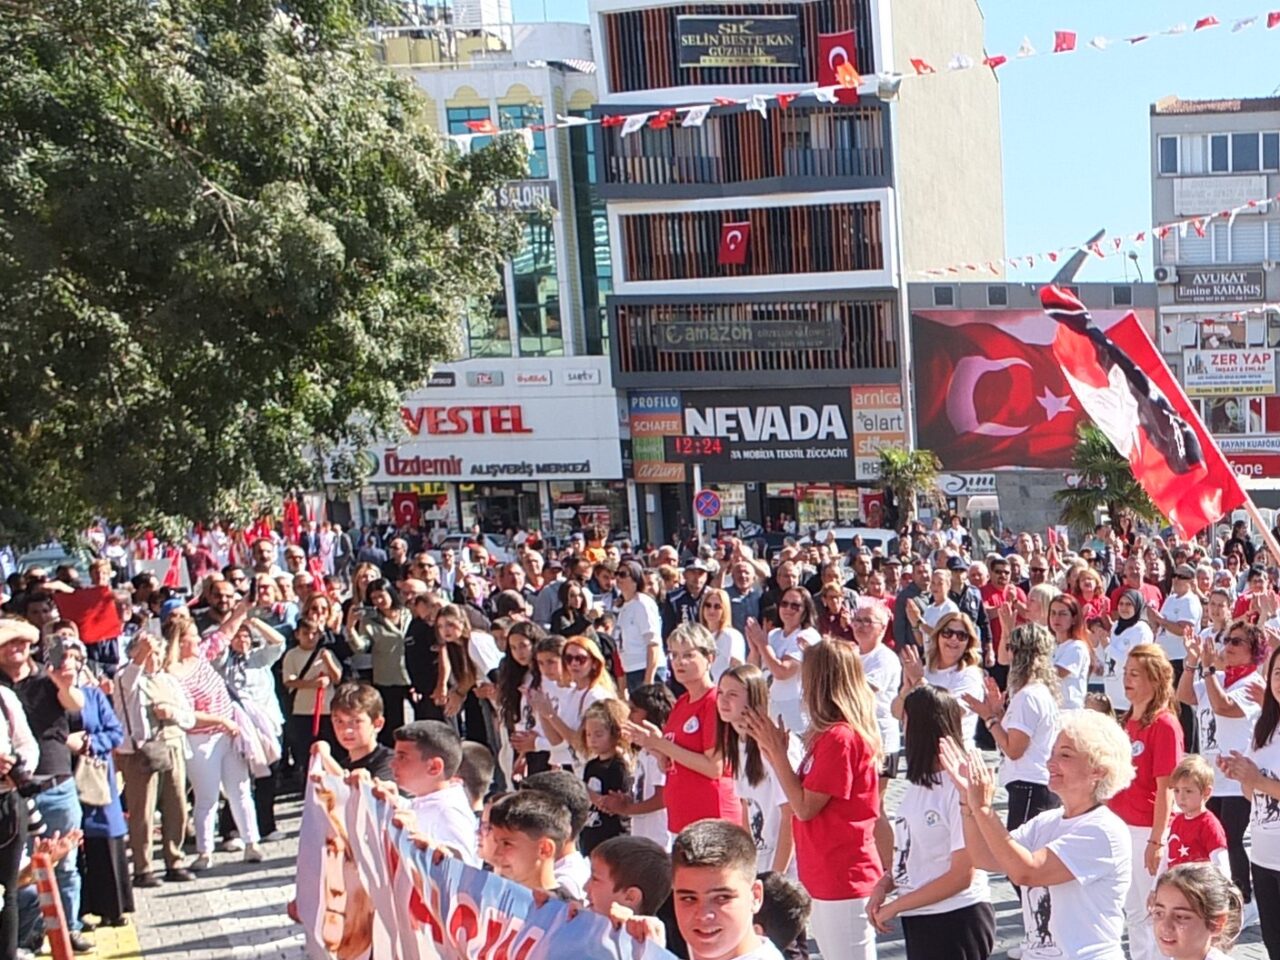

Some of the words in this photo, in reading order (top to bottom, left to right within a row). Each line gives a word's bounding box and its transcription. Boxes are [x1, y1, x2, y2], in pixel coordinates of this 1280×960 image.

[766, 34, 794, 46] KAN
[1193, 273, 1247, 285] AVUKAT
[1180, 286, 1211, 296] Emine
[1213, 284, 1261, 299] KARAKIŞ
[685, 325, 752, 341] amazon
[1211, 353, 1238, 366] ZER
[1242, 352, 1272, 364] YAP
[854, 391, 902, 405] arnica
[401, 405, 533, 435] VESTEL
[685, 404, 848, 442] NEVADA
[675, 437, 723, 455] 12:24
[384, 447, 463, 476] Özdemir
[470, 461, 534, 477] ALIŞVERİŞ
[535, 460, 591, 474] MERKEZİ
[1230, 461, 1263, 475] fone
